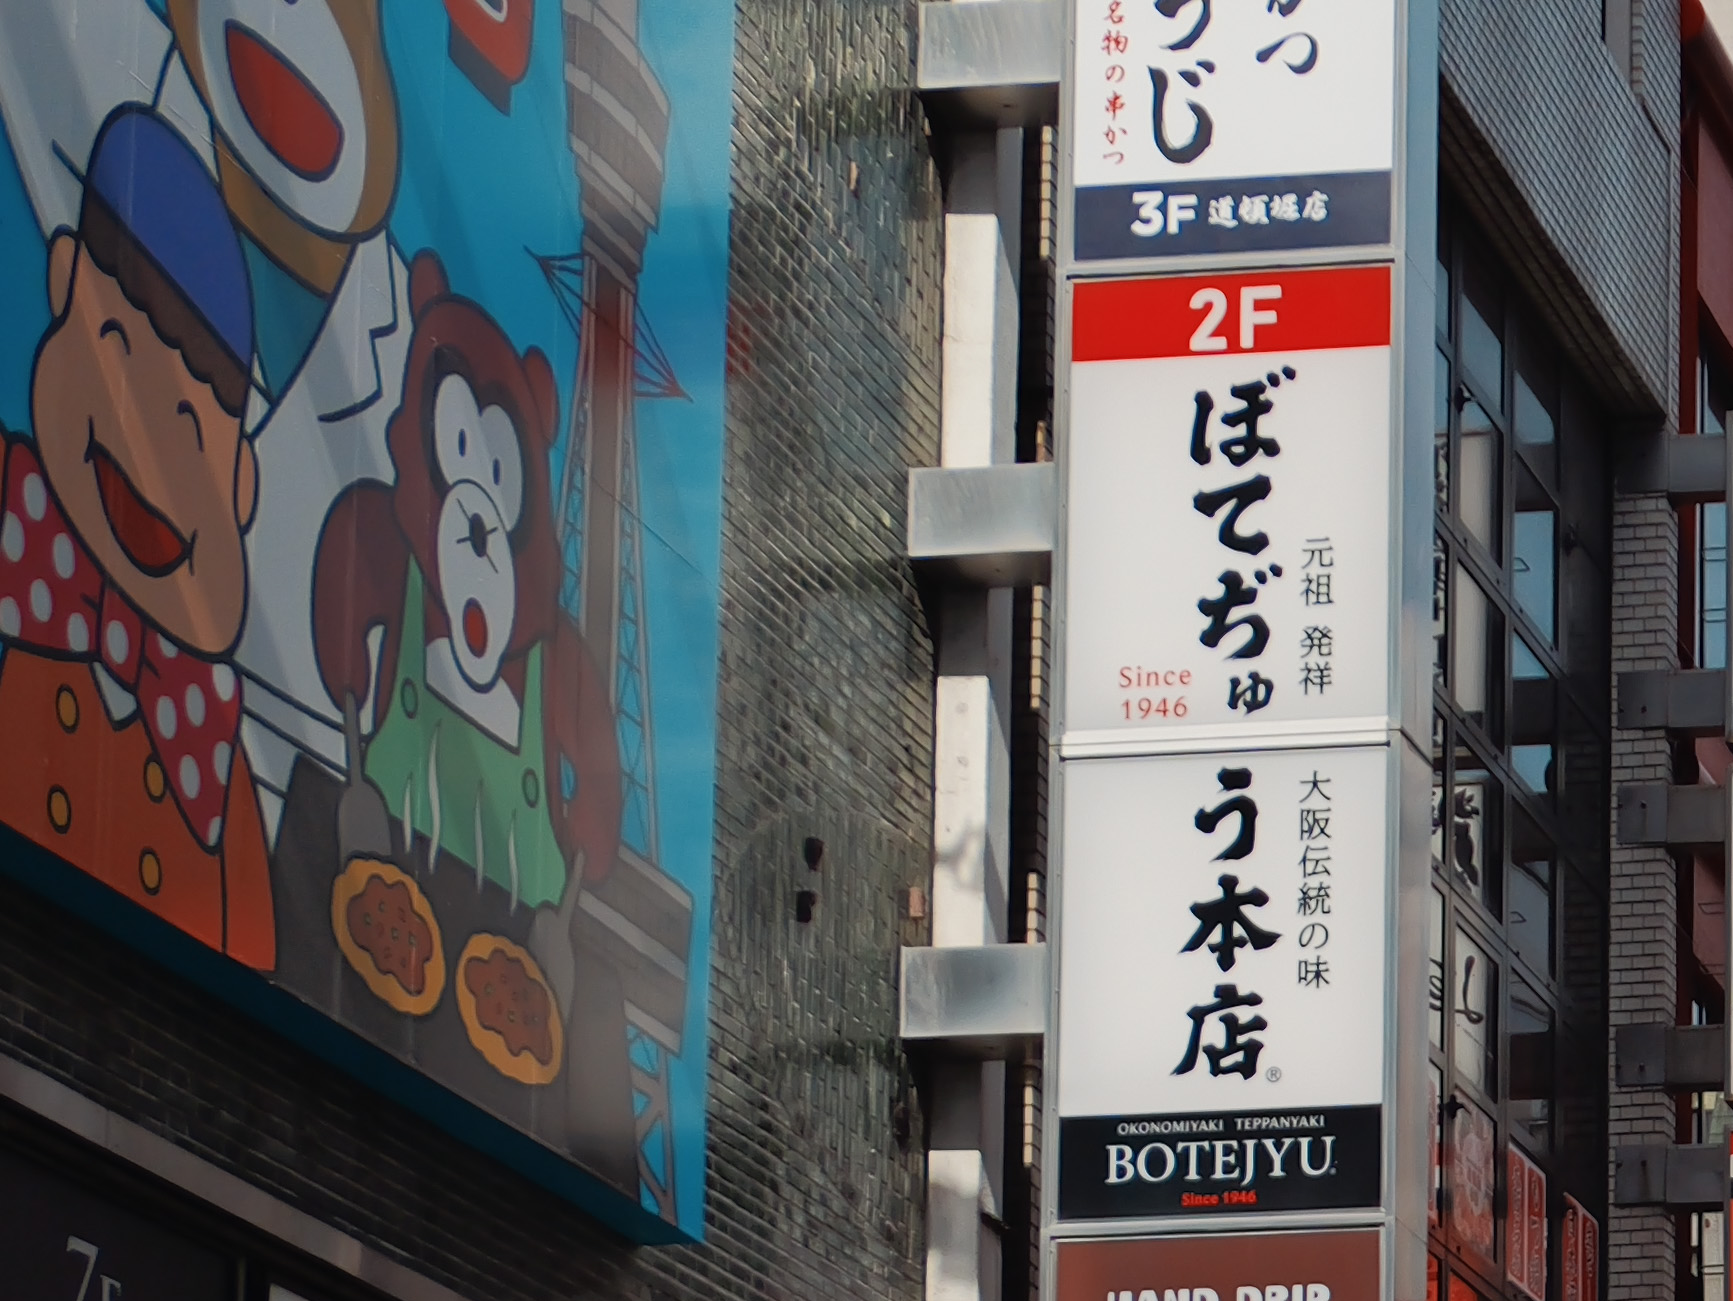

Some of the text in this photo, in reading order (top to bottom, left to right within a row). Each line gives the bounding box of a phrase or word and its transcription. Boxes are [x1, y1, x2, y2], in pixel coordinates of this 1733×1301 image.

[1256, 0, 1319, 75] つ
[1130, 190, 1198, 237] 3F
[1188, 284, 1283, 352] 2F
[1300, 536, 1334, 696] 元祖 発祥
[1118, 664, 1192, 690] Since
[1119, 696, 1189, 721] 1946
[1298, 770, 1333, 989] 大阪伝統の味
[1117, 1114, 1326, 1135] OKONOMIYAKI TEPPANYAKI
[1105, 1135, 1337, 1186] BOTEJYU
[1181, 1189, 1257, 1207] Since 1946
